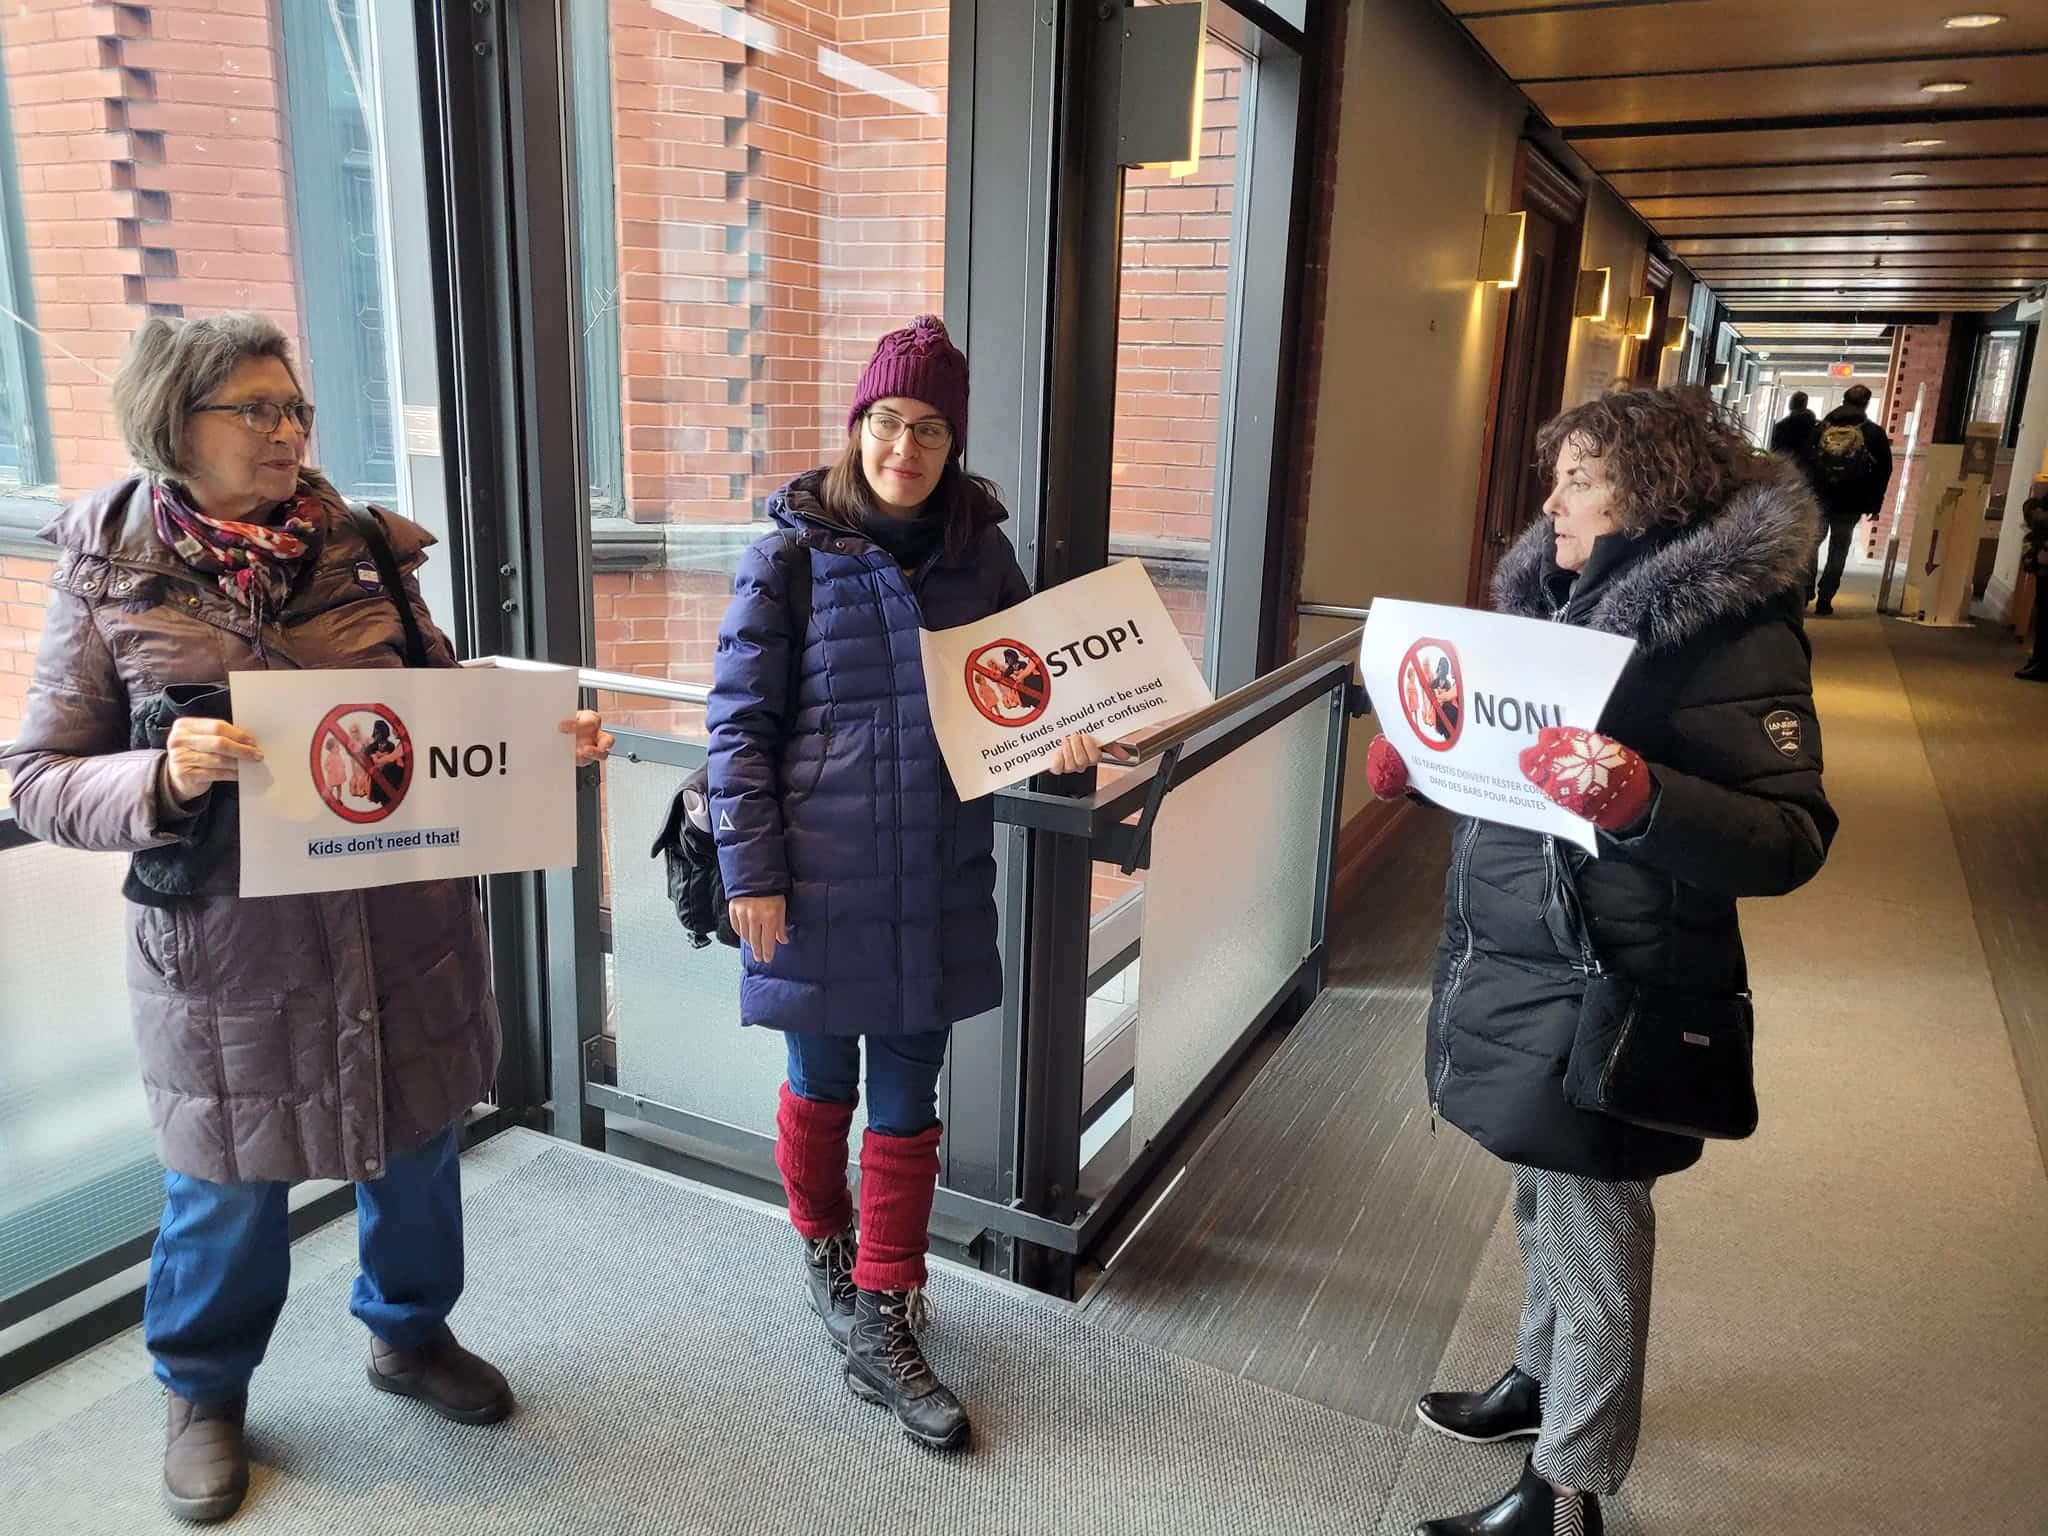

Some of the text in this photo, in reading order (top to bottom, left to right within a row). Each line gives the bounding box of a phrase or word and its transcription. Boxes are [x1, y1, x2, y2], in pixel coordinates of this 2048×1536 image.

[1046, 619, 1144, 677] STOP!
[981, 678, 1163, 760] Public funds should not be used
[1474, 691, 1562, 735] NON!
[988, 696, 1168, 775] to propagate nder confusion.
[429, 741, 507, 779] NO!
[1483, 790, 1507, 803] POUR
[1508, 795, 1547, 811] ADULTES
[308, 830, 460, 857] Kids don't need that!
